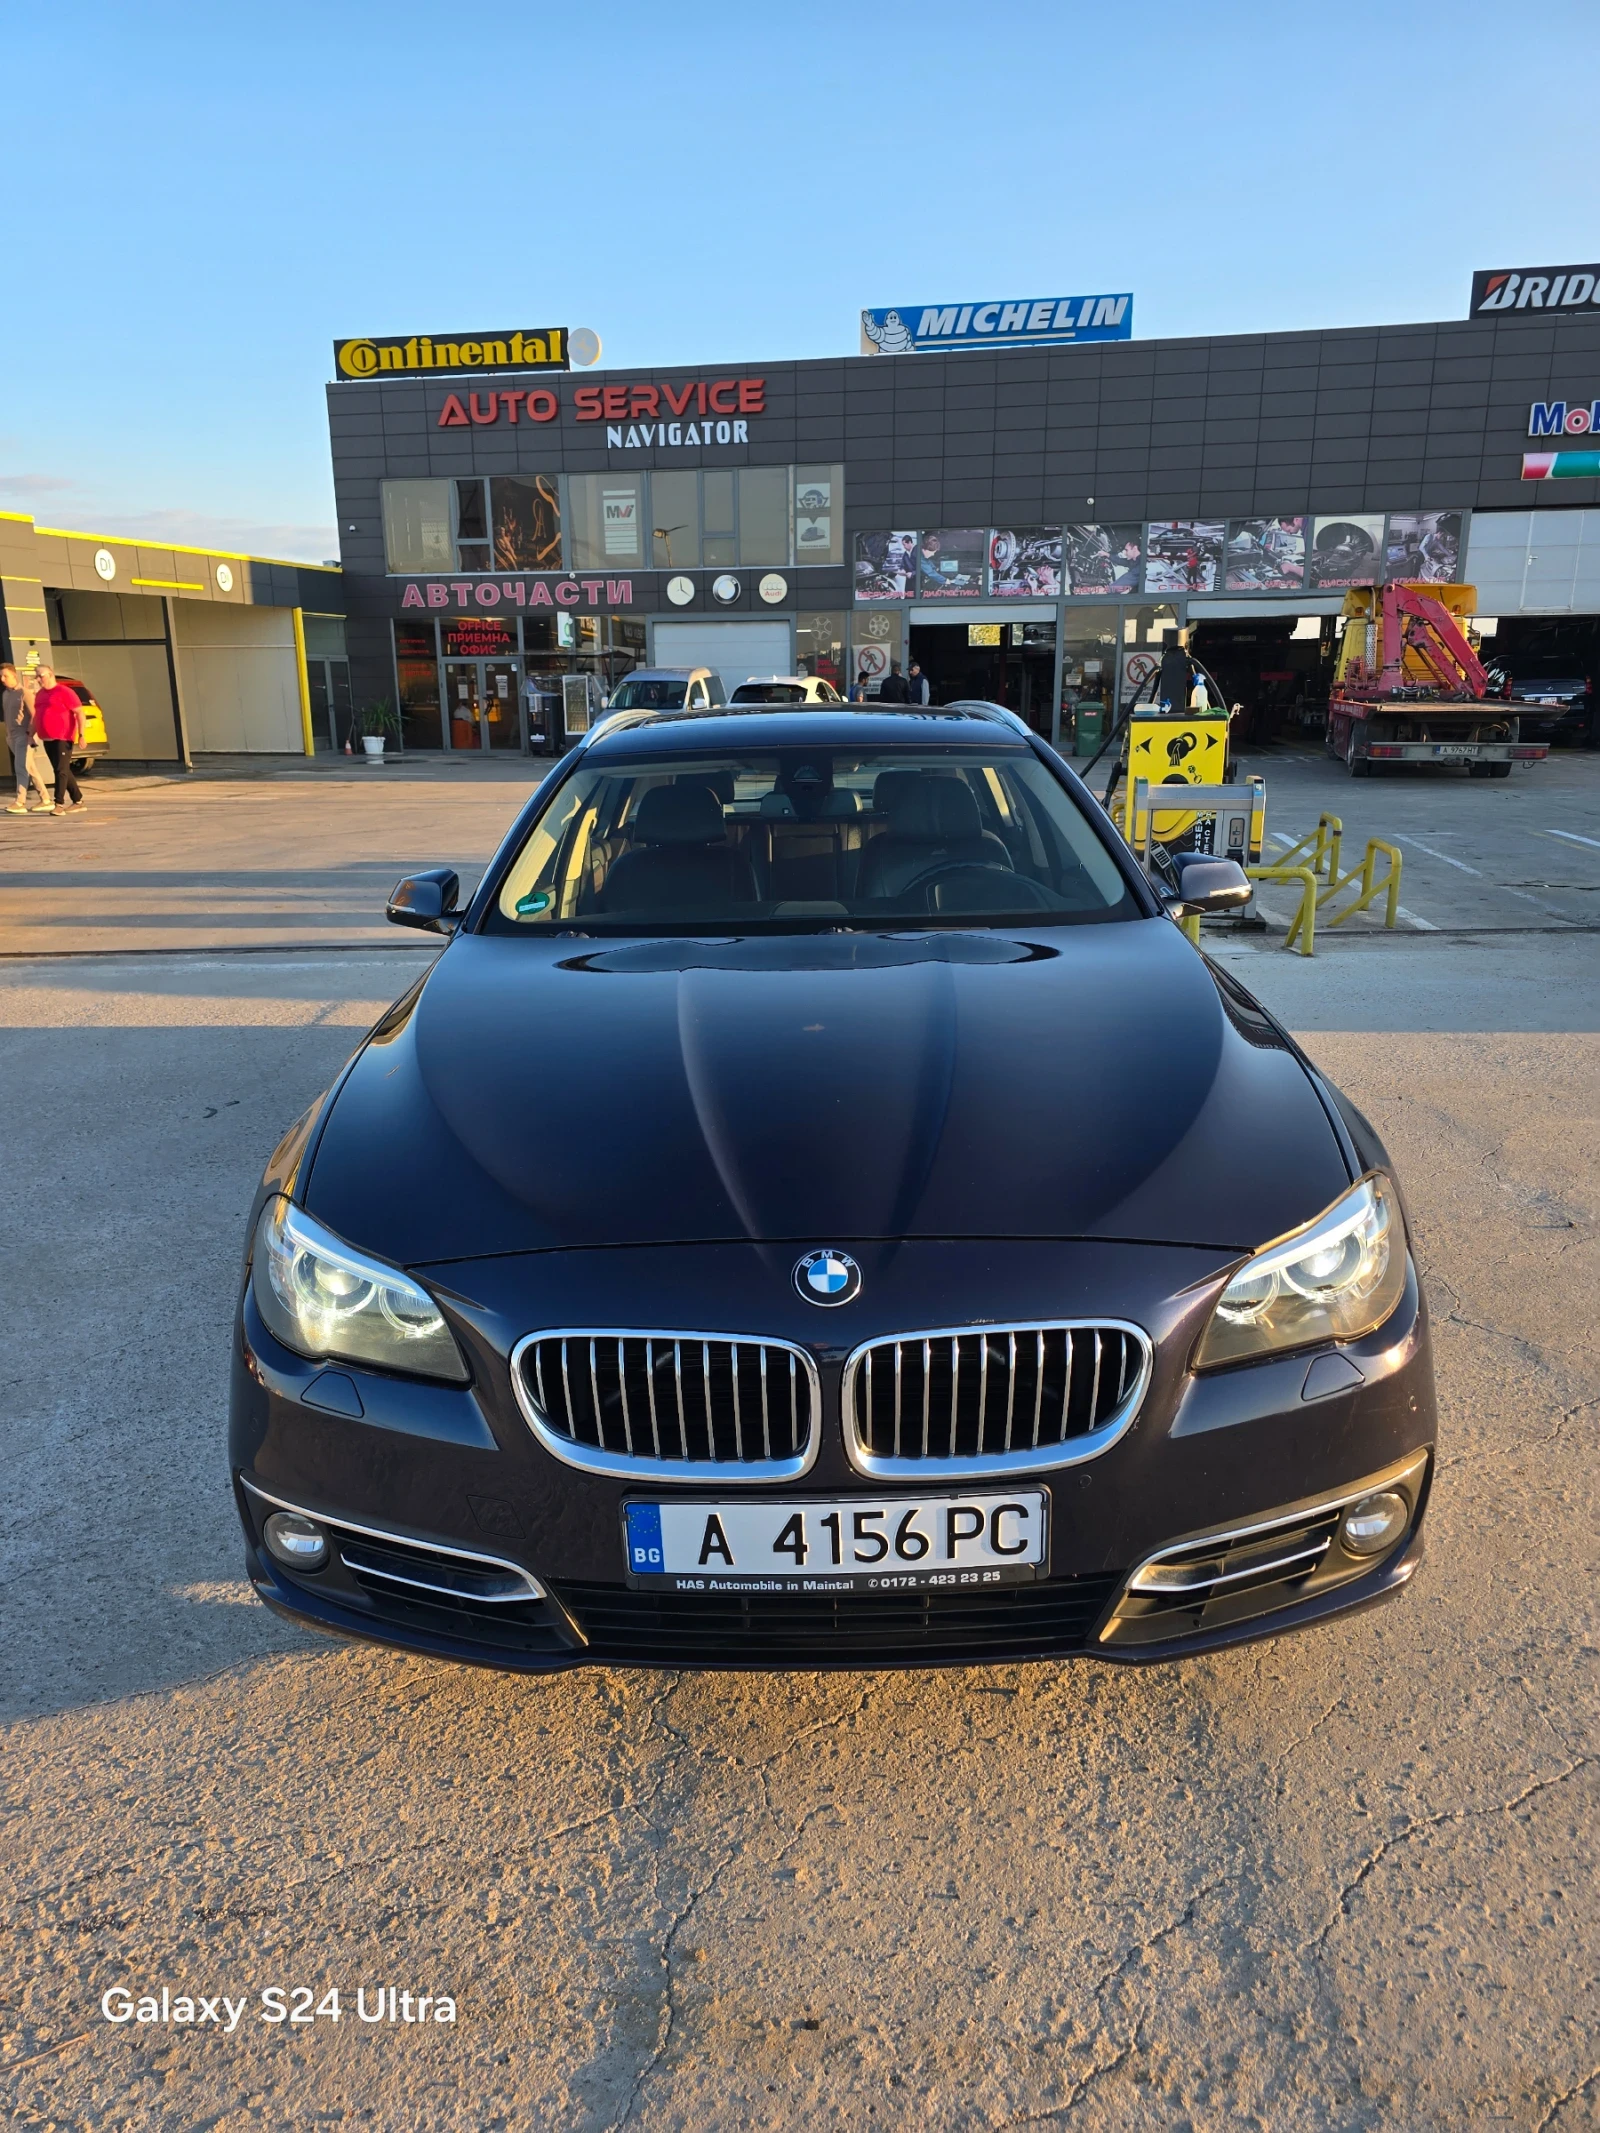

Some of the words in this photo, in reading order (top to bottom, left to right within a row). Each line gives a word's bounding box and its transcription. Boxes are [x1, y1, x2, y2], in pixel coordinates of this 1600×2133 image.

[917, 297, 1128, 336] MICHELIN
[338, 329, 564, 377] Continental
[438, 389, 558, 427] AUTO
[573, 379, 765, 421] SERVICE
[607, 420, 748, 449] NAVIGATOR
[1033, 586, 1058, 595] ЧАСТ
[1318, 578, 1374, 588] ДИСКОВЕ
[401, 580, 633, 608] АВТОЧАСТИ
[923, 589, 979, 598] ДИАГНОСТИКА
[457, 621, 501, 631] OFFICE
[448, 633, 511, 643] ПРИЕМНА
[459, 645, 497, 655] ОФИС
[1195, 811, 1203, 854] МАШИНА
[802, 1250, 855, 1268] BMW
[698, 1512, 734, 1565] A
[773, 1508, 930, 1566] 4156
[946, 1503, 1029, 1559] PC
[634, 1547, 660, 1563] BG
[676, 1580, 704, 1590] HAS
[709, 1580, 782, 1590] Automobile
[787, 1580, 798, 1590] in
[803, 1579, 854, 1590] Maintal
[880, 1576, 917, 1588] 0172
[929, 1574, 956, 1585] 423
[961, 1572, 979, 1583] 23
[983, 1571, 1001, 1581] 25
